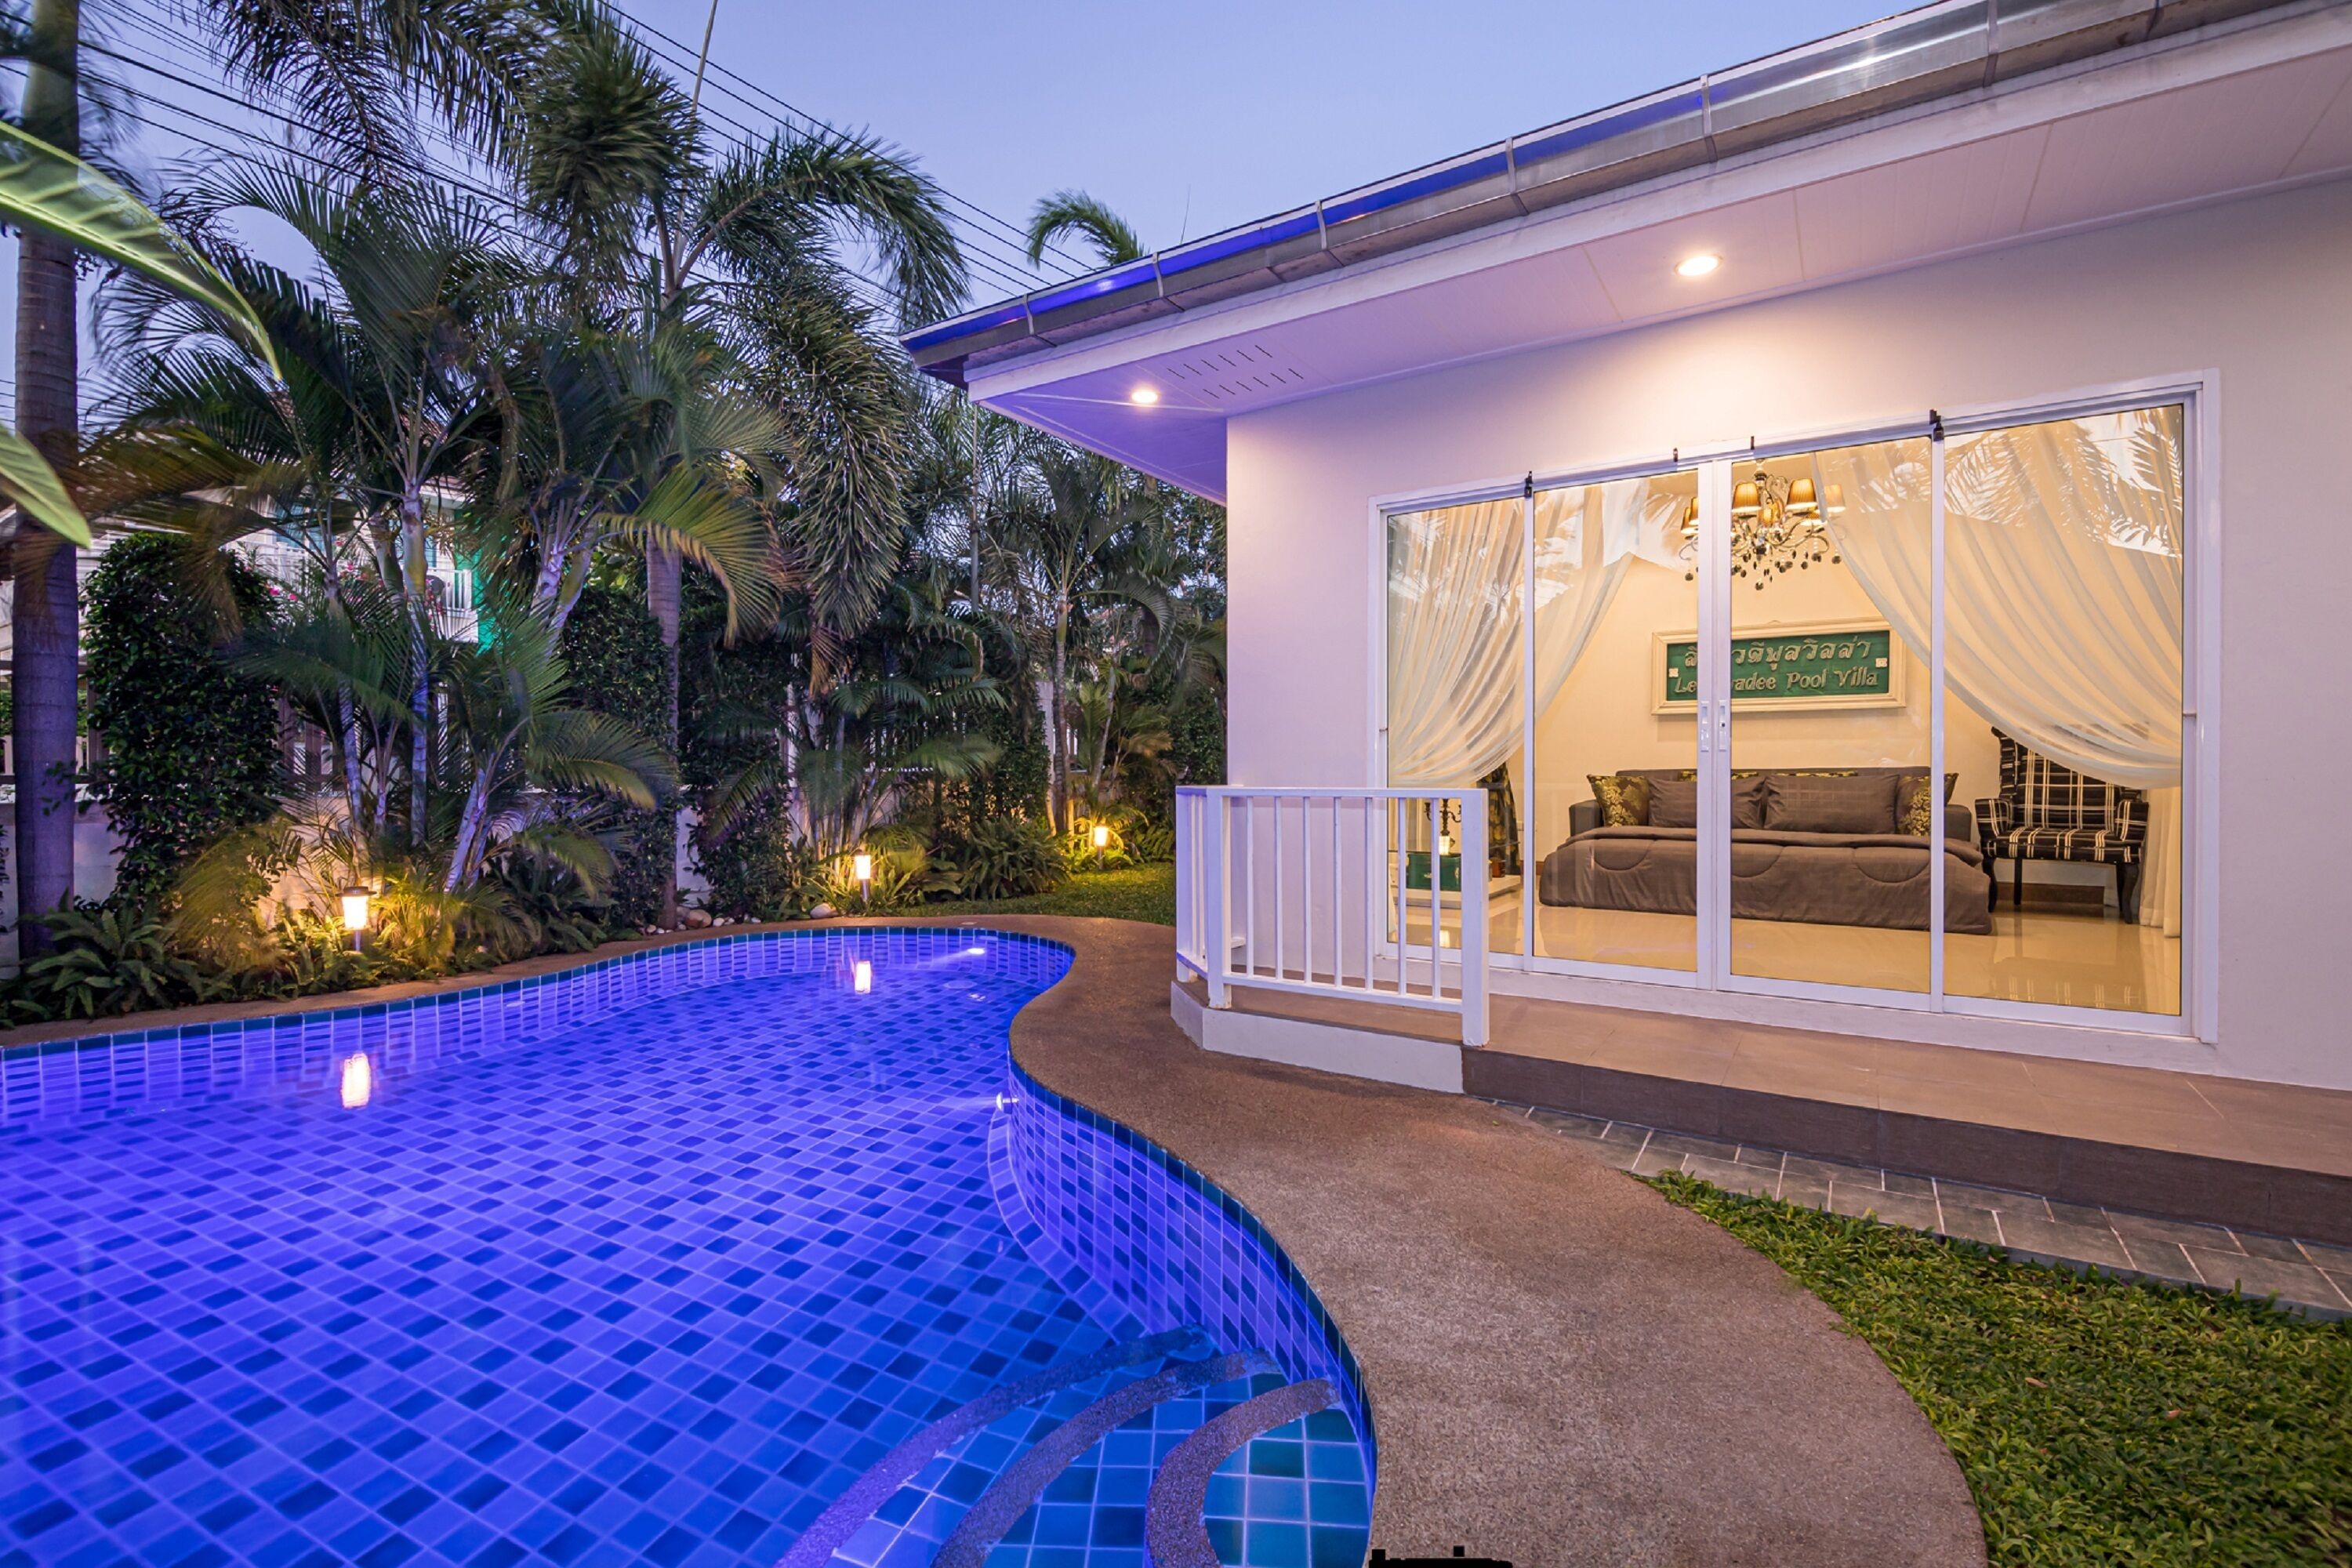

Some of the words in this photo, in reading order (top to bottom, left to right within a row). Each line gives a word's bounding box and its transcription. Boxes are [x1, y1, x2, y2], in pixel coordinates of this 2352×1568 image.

[1675, 672, 1777, 693] Leadee
[1786, 668, 1828, 689] Pool
[1833, 666, 1878, 687] Villa
